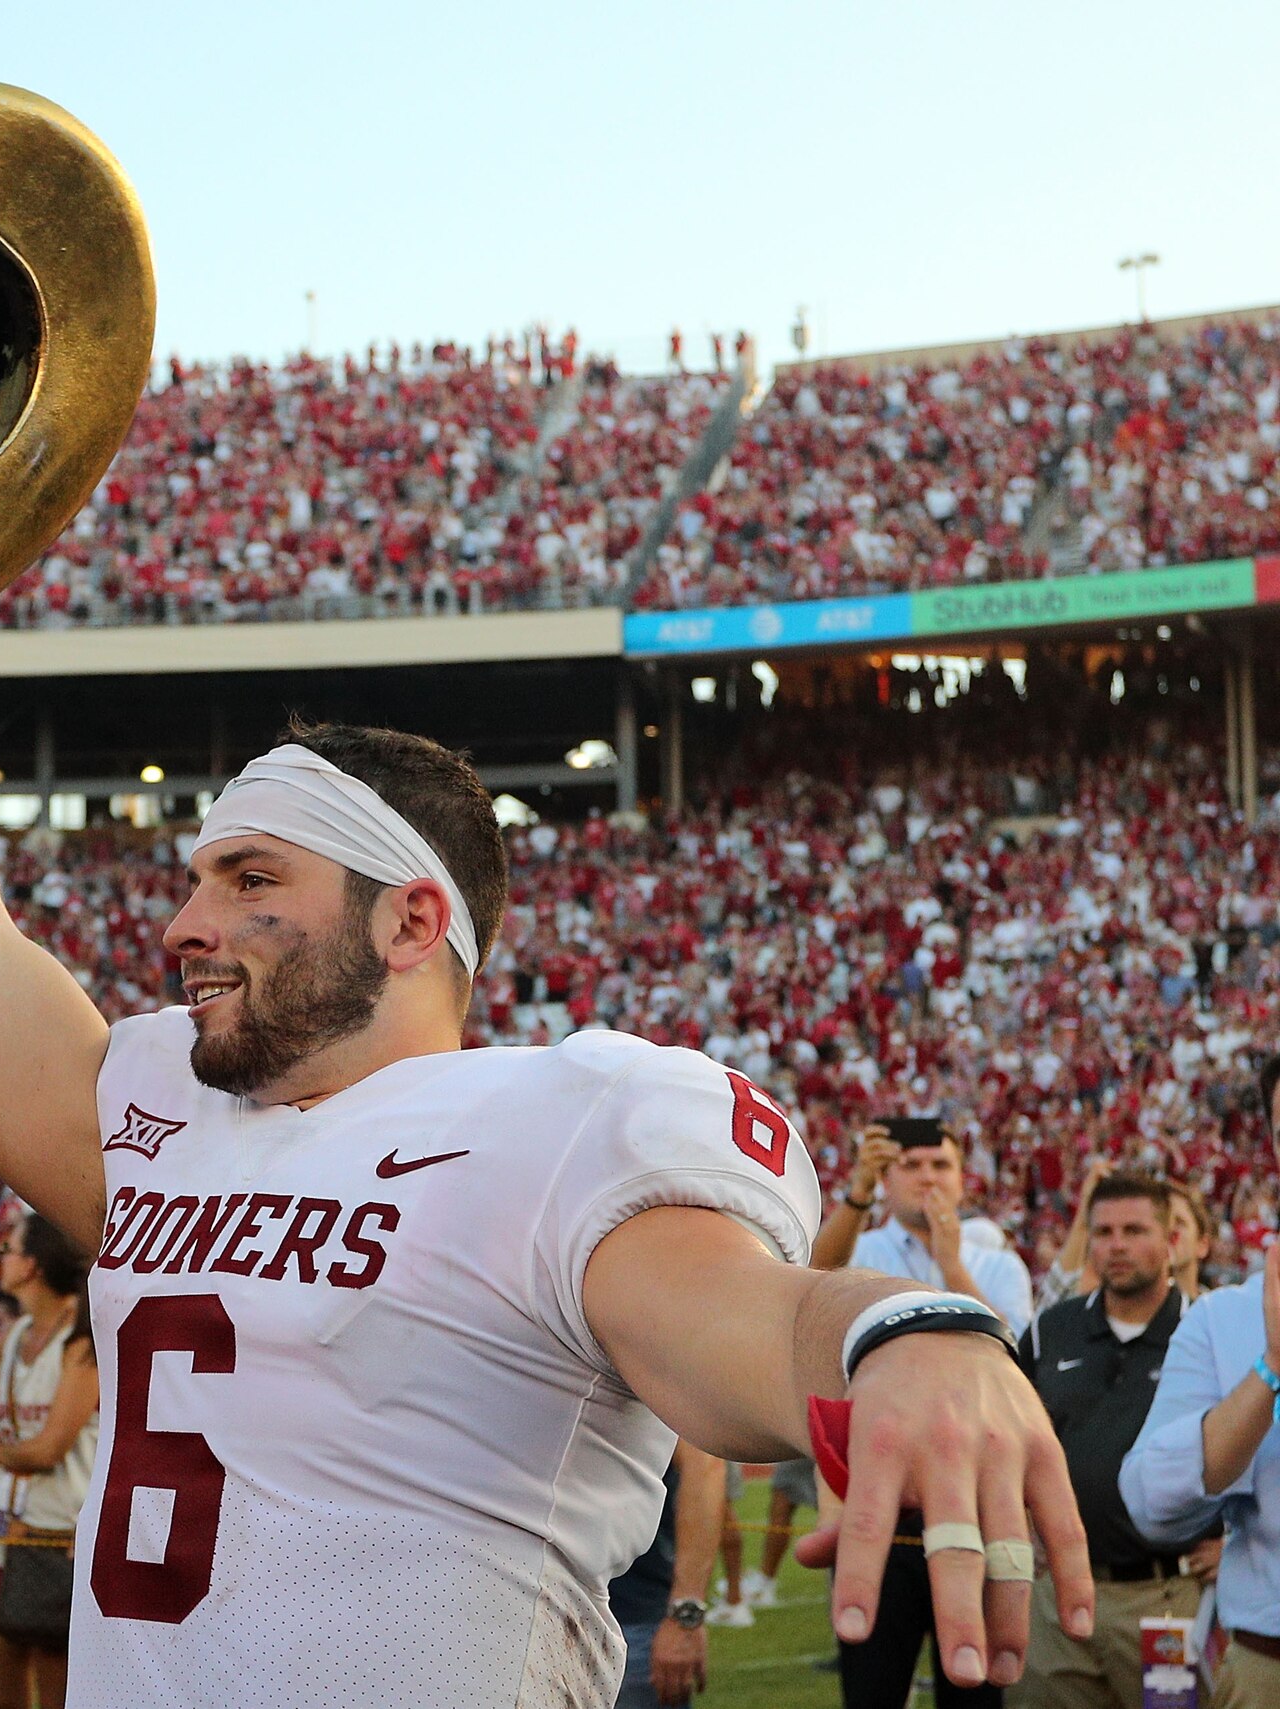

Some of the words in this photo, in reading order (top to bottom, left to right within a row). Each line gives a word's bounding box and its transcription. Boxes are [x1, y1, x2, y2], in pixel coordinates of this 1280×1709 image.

[816, 604, 875, 632] AT&T
[933, 588, 1069, 627] StubHub
[657, 616, 715, 642] AT&T
[106, 1106, 184, 1157] XII
[724, 1071, 790, 1177] 6
[884, 1310, 917, 1326] GO
[89, 1293, 236, 1624] 6
